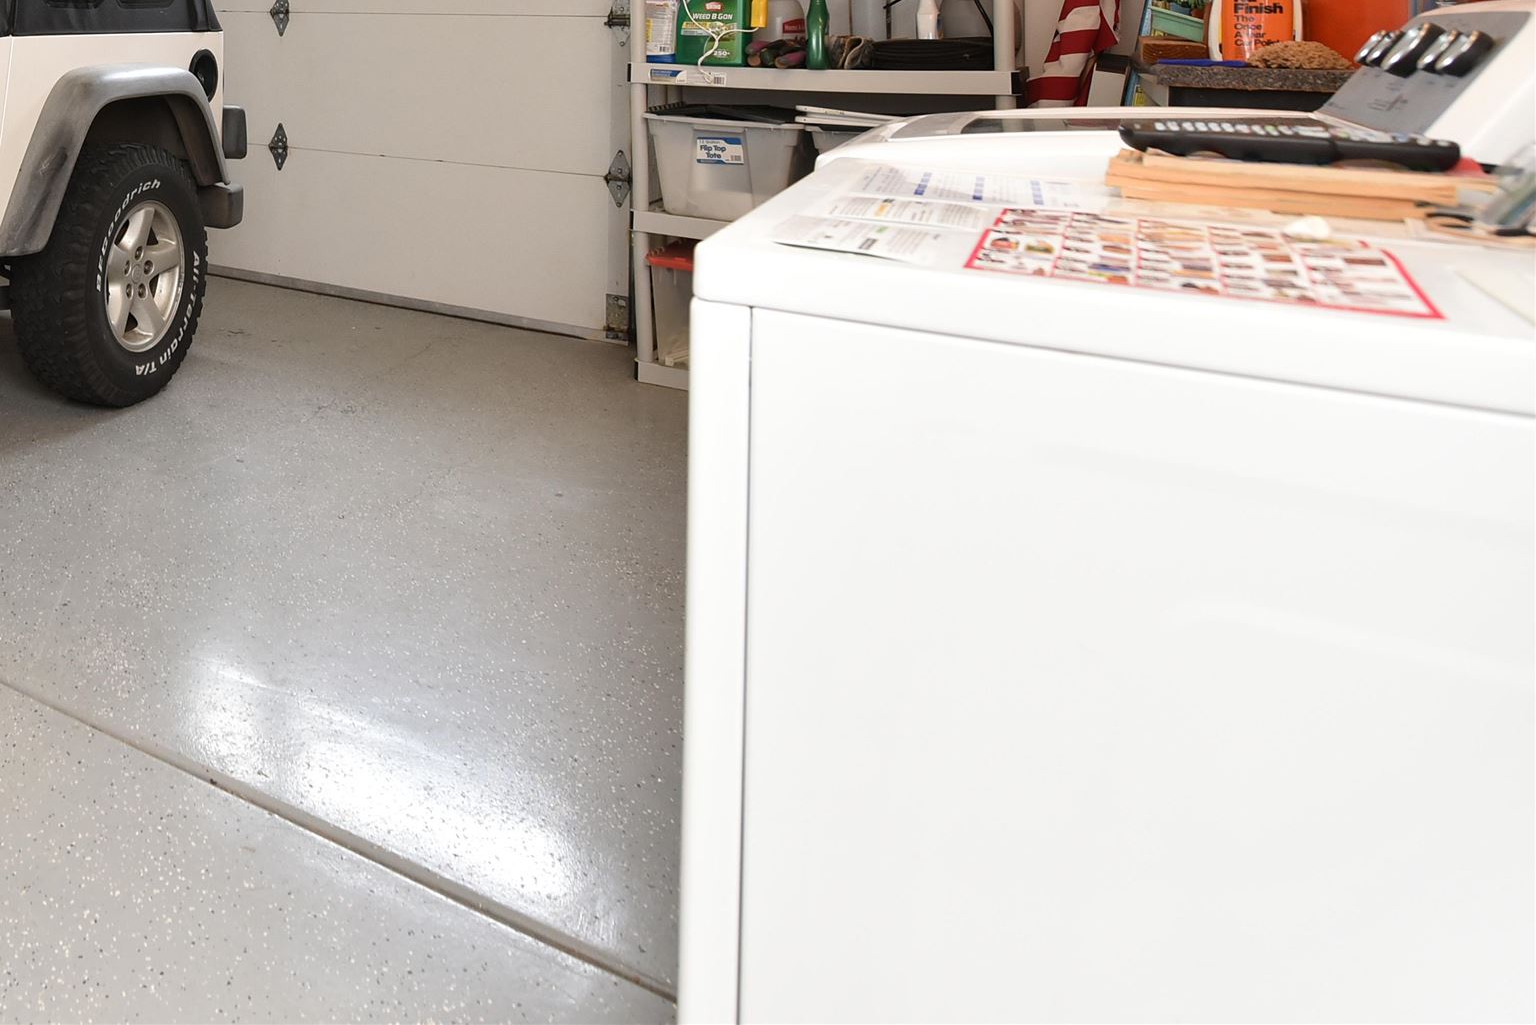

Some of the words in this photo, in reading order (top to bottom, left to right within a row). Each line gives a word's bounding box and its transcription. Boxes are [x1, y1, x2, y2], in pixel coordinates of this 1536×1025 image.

[1234, 3, 1283, 14] Finish
[700, 144, 713, 152] Flip
[713, 144, 727, 153] Top
[706, 151, 722, 159] Tote
[159, 250, 200, 365] All-Terrain
[135, 359, 158, 376] T/A
